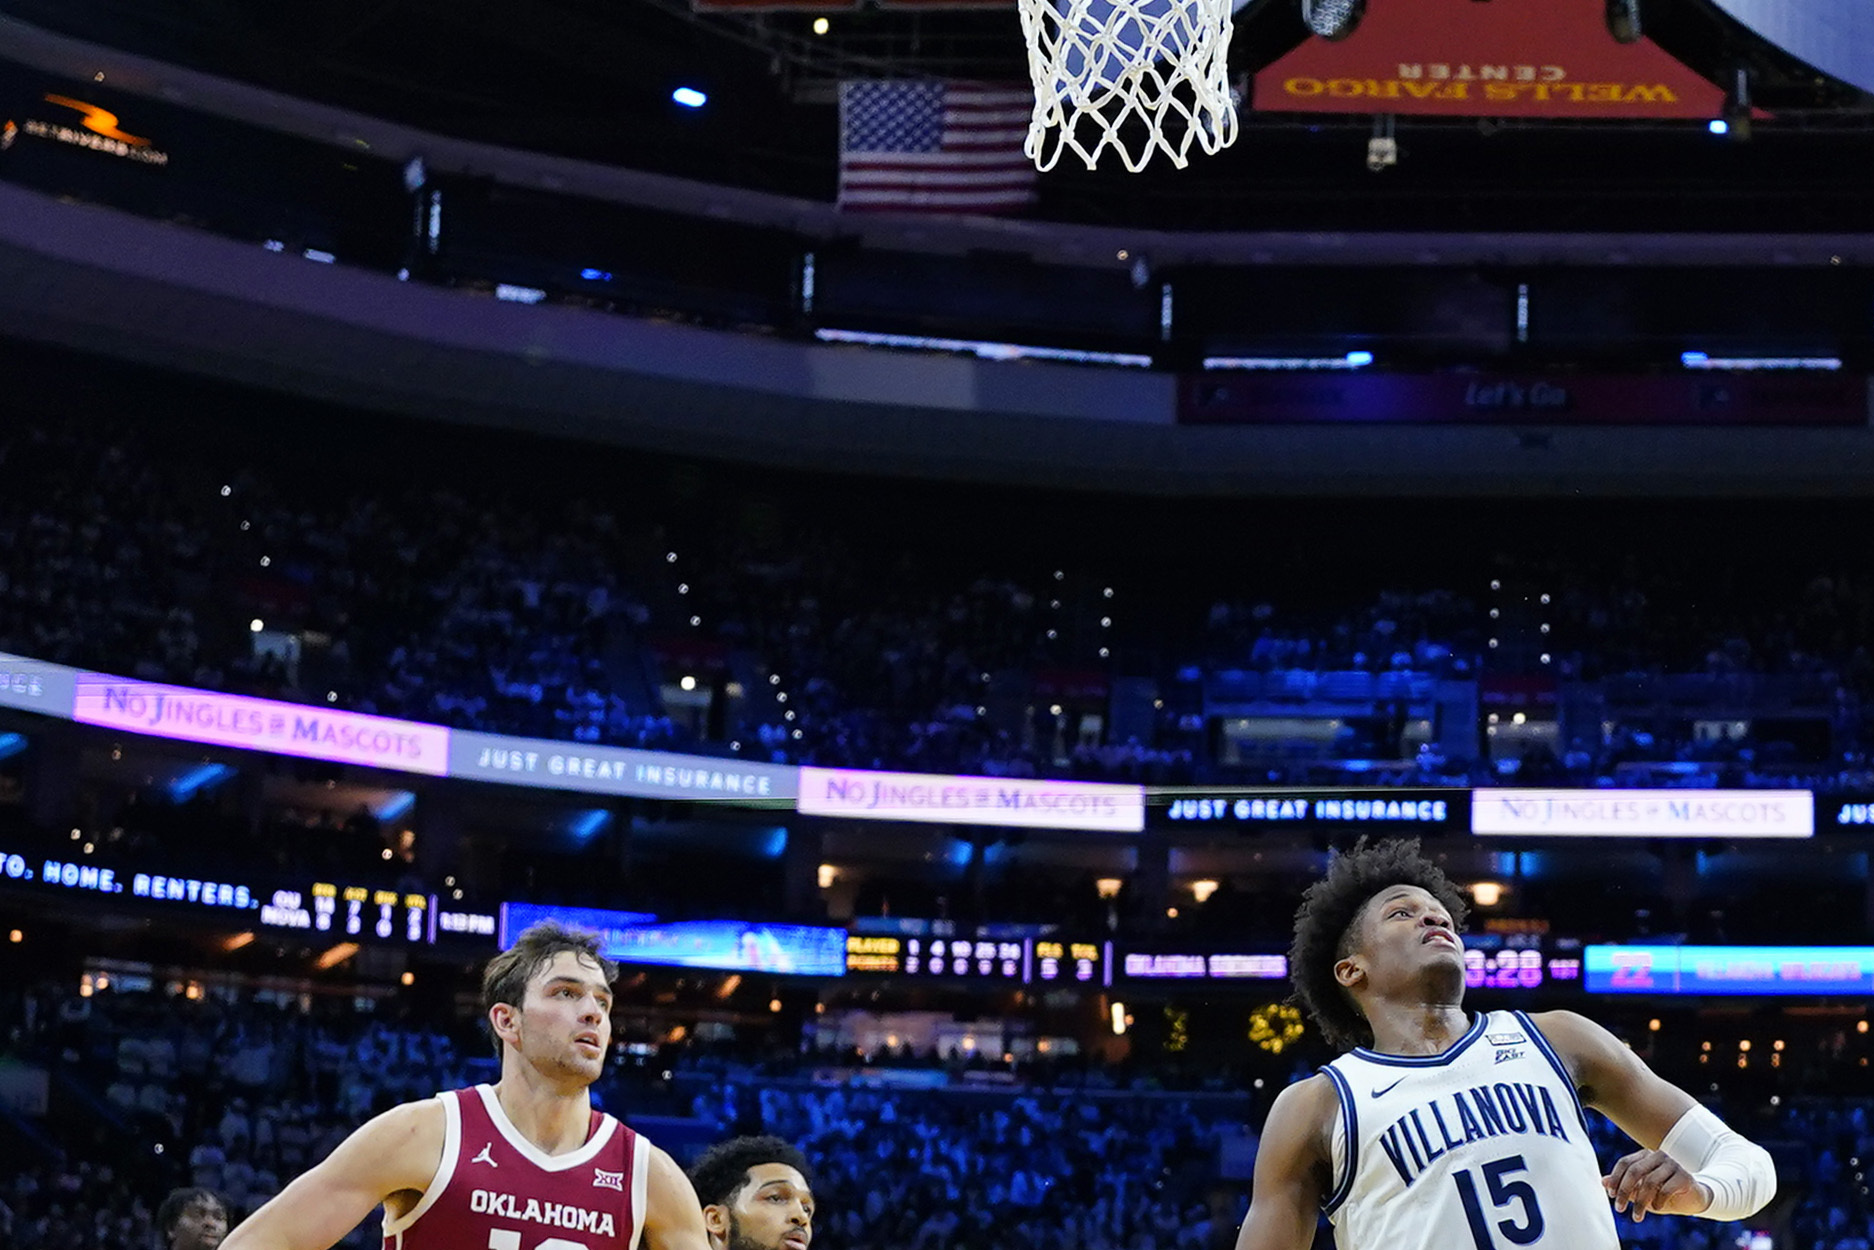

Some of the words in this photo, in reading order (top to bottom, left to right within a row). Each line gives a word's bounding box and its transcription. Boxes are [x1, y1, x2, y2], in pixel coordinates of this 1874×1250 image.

[1283, 76, 1470, 101] FARGO
[1399, 63, 1567, 82] CENTER
[1485, 81, 1678, 103] WELLS
[103, 686, 147, 718] NO
[149, 695, 263, 735] JINGLES
[291, 717, 422, 760] MASCOTS
[478, 747, 540, 773] JUST
[547, 755, 627, 781] GREAT
[635, 763, 771, 795] INSURANCE
[867, 781, 970, 810] JINGLES
[997, 787, 1117, 817] MASCOTS
[1168, 799, 1227, 821] JUST
[1233, 799, 1309, 821] GREAT
[1314, 799, 1447, 822] INSURANCE
[846, 936, 899, 954] PLAYER
[1610, 952, 1654, 988] 22
[1379, 1081, 1572, 1189] VILLANOVA
[470, 1188, 616, 1238] OKLAHOMA
